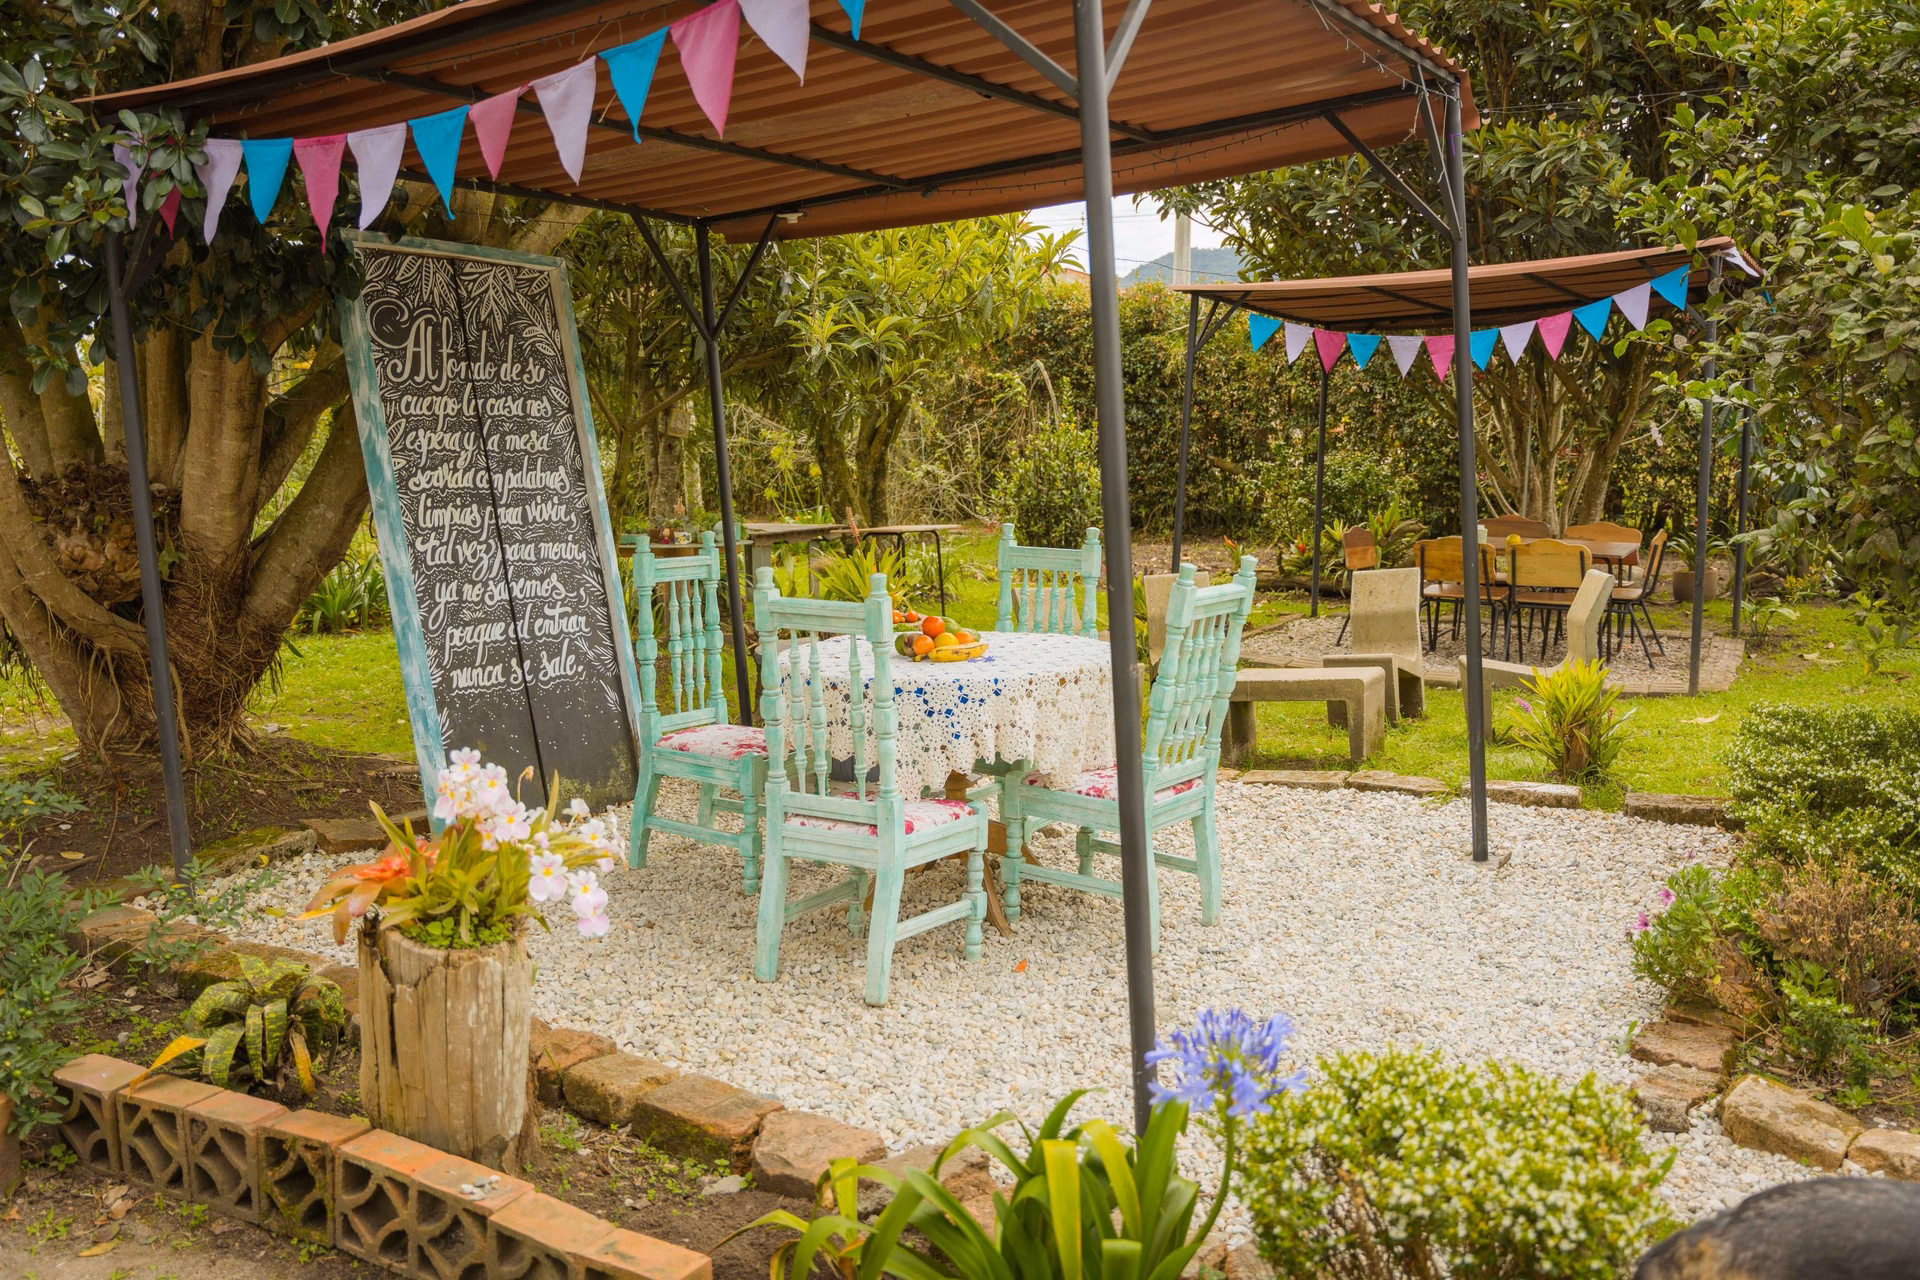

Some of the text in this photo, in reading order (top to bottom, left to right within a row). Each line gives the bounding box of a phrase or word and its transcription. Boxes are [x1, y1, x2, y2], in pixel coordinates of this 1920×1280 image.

[367, 298, 545, 392] Al fondo de su
[401, 394, 462, 431] cuerpo
[486, 396, 525, 416] casa
[527, 396, 552, 417] nos
[406, 430, 461, 467] espera
[457, 432, 477, 469] y
[505, 430, 552, 453] mesa
[408, 455, 570, 504] servida con palabras
[419, 493, 577, 542] limpias para vivir,
[415, 531, 586, 580] tal vez para morir,
[429, 582, 457, 630] ya
[462, 582, 484, 601] no
[443, 602, 591, 666] porque al entrar
[450, 663, 506, 689] nunca
